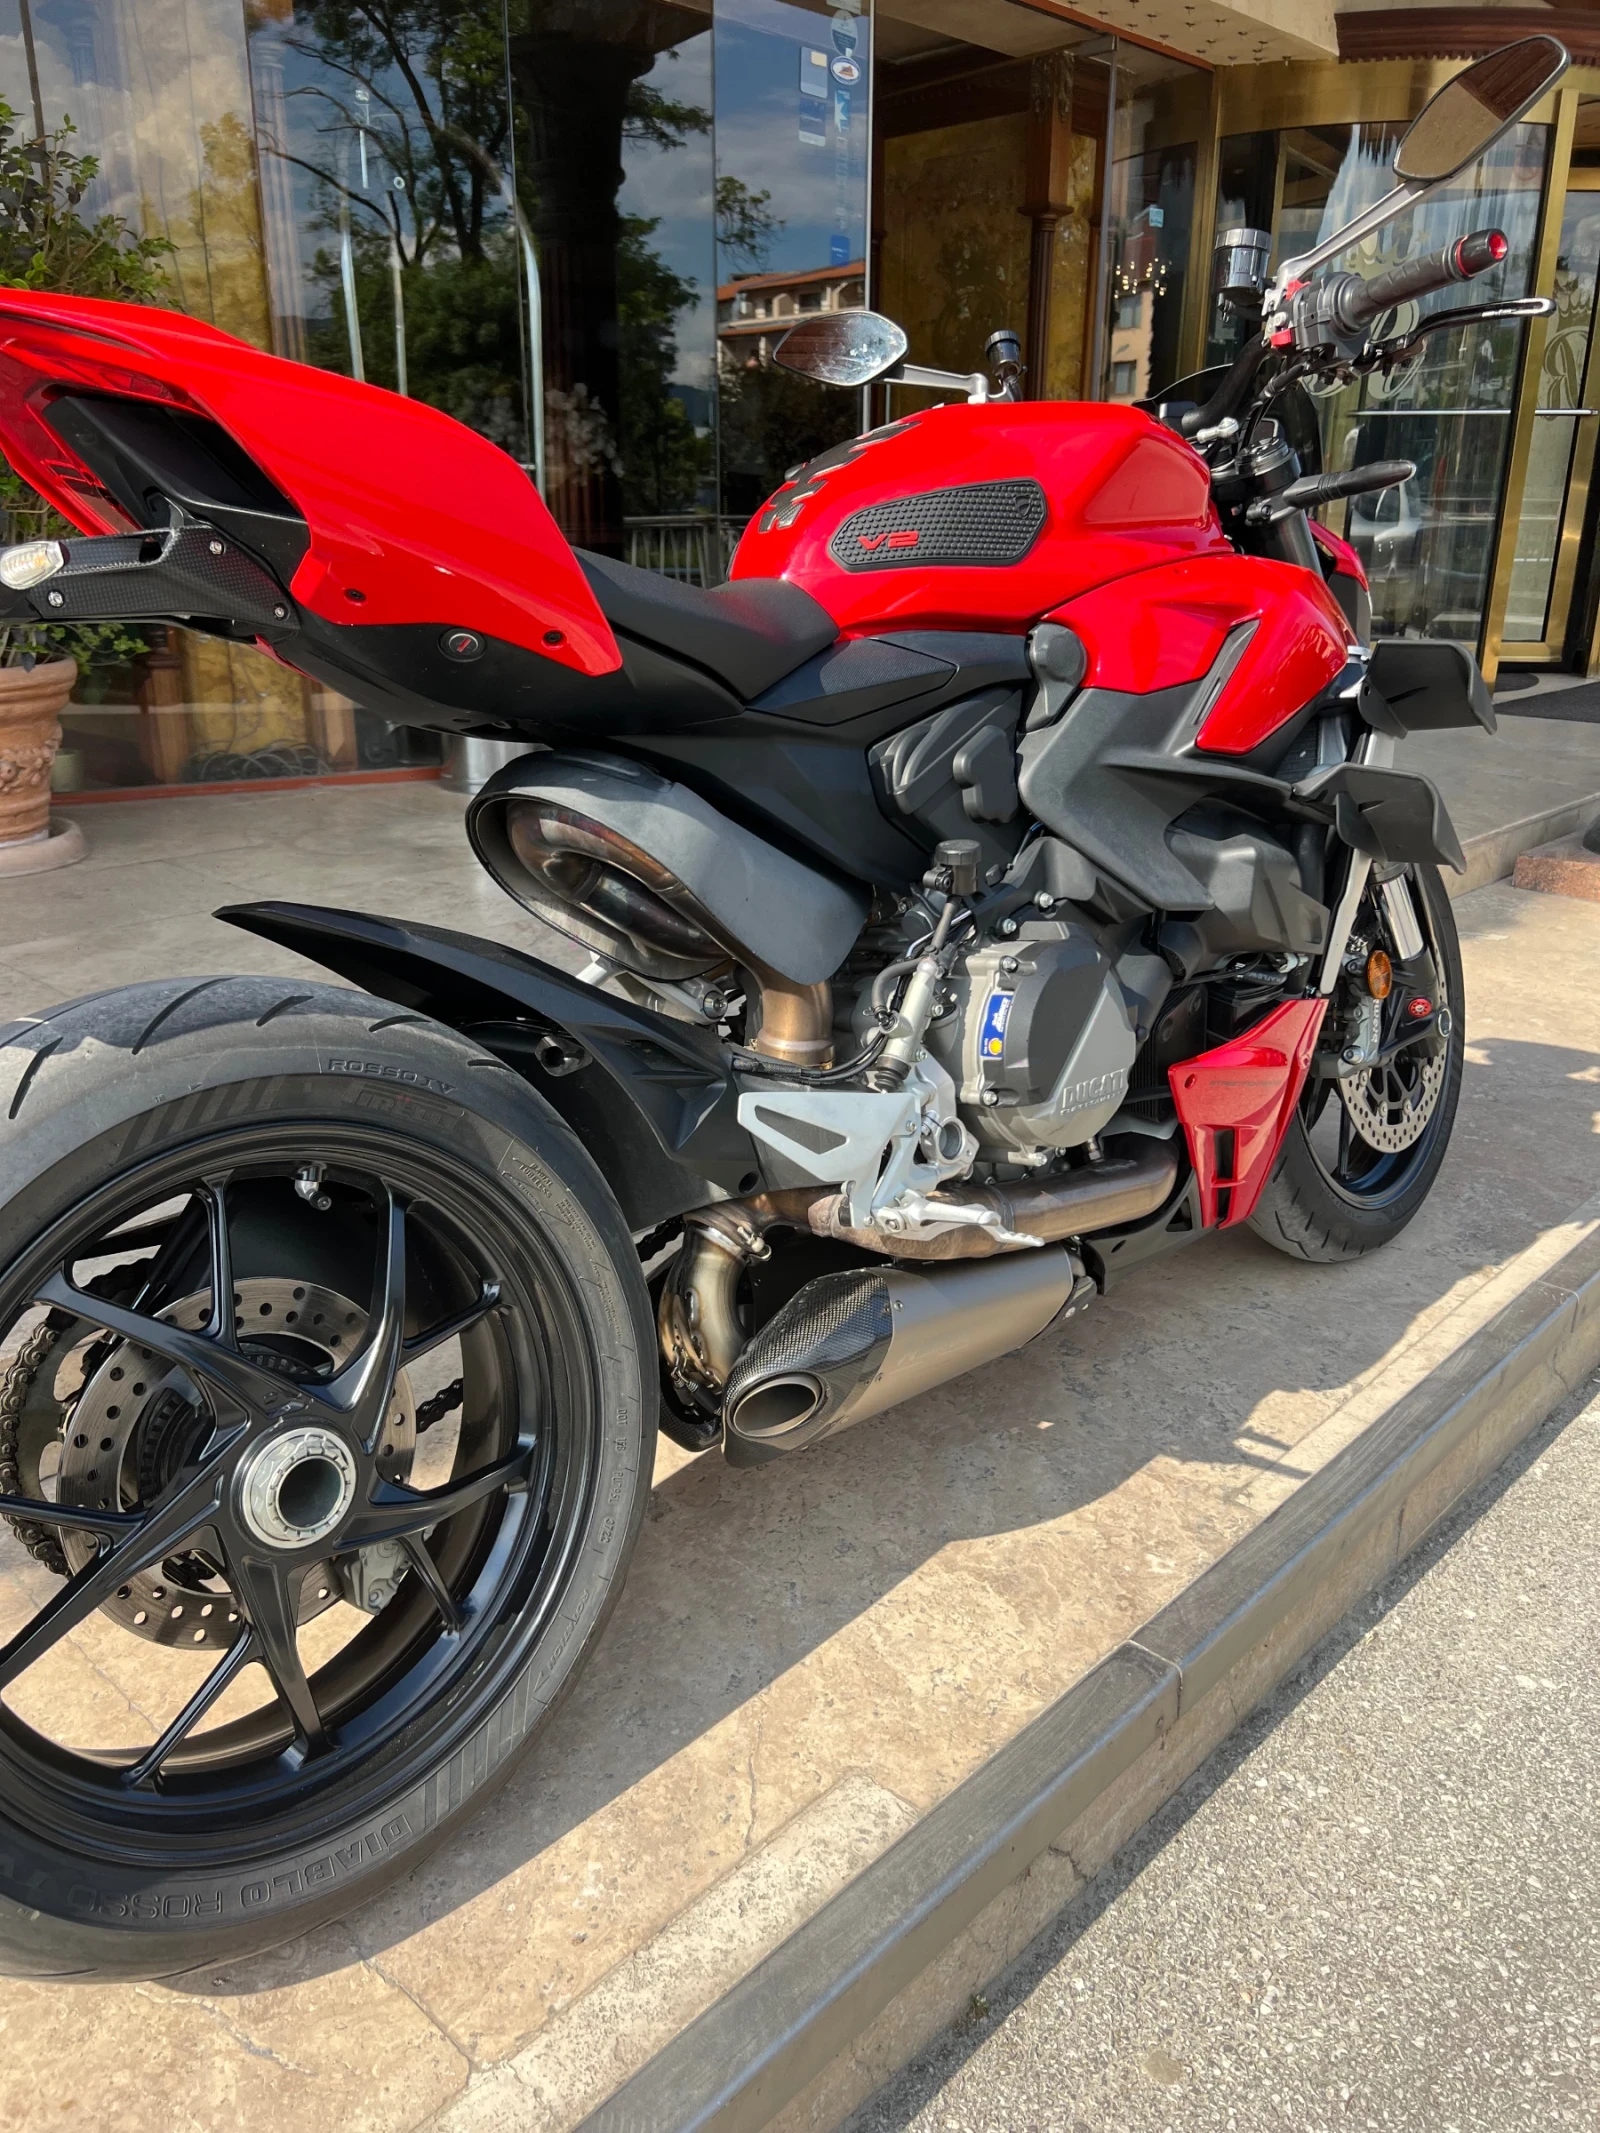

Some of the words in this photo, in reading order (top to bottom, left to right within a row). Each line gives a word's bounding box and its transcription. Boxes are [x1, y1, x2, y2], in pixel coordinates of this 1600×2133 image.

[857, 530, 920, 551] V2
[328, 1058, 418, 1083] ROSSO
[420, 1075, 458, 1095] IV
[1062, 1068, 1127, 1109] DUCATI
[519, 1164, 553, 1199] TUBELESS
[616, 1408, 628, 1426] DOT
[600, 1517, 616, 1544] 3722
[547, 1588, 590, 1671] ROTATION
[239, 1814, 414, 1909] DIABLO
